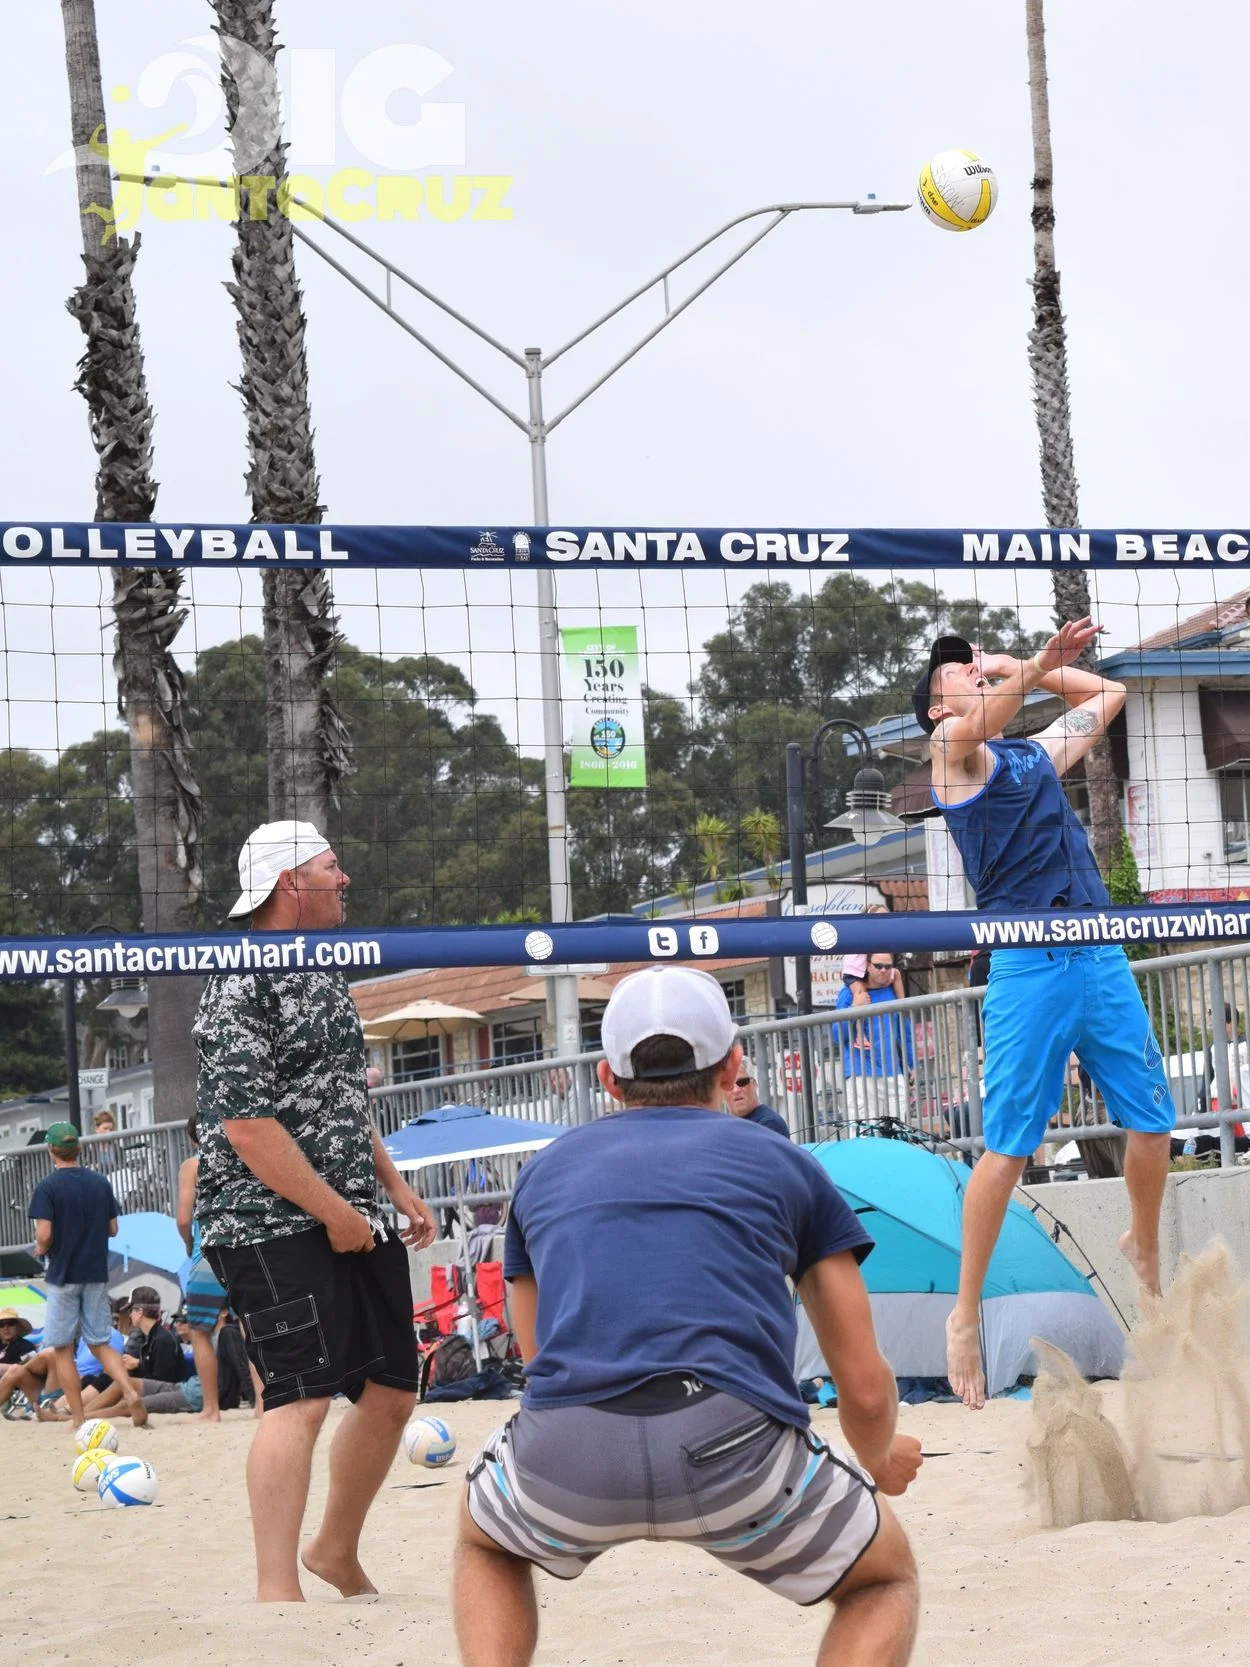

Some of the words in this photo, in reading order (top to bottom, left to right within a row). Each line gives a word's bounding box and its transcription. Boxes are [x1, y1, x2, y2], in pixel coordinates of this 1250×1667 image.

[3, 527, 348, 560] OLLEYBALL
[546, 531, 706, 561] SANTA
[720, 532, 849, 562] CRUZ
[962, 533, 1091, 562] MAIN
[583, 658, 624, 678] 150
[583, 679, 624, 692] Years
[583, 693, 628, 705] Creating
[585, 706, 629, 716] Community
[612, 760, 637, 769] 2016
[0, 936, 381, 973] ww.santacruzwharf.com
